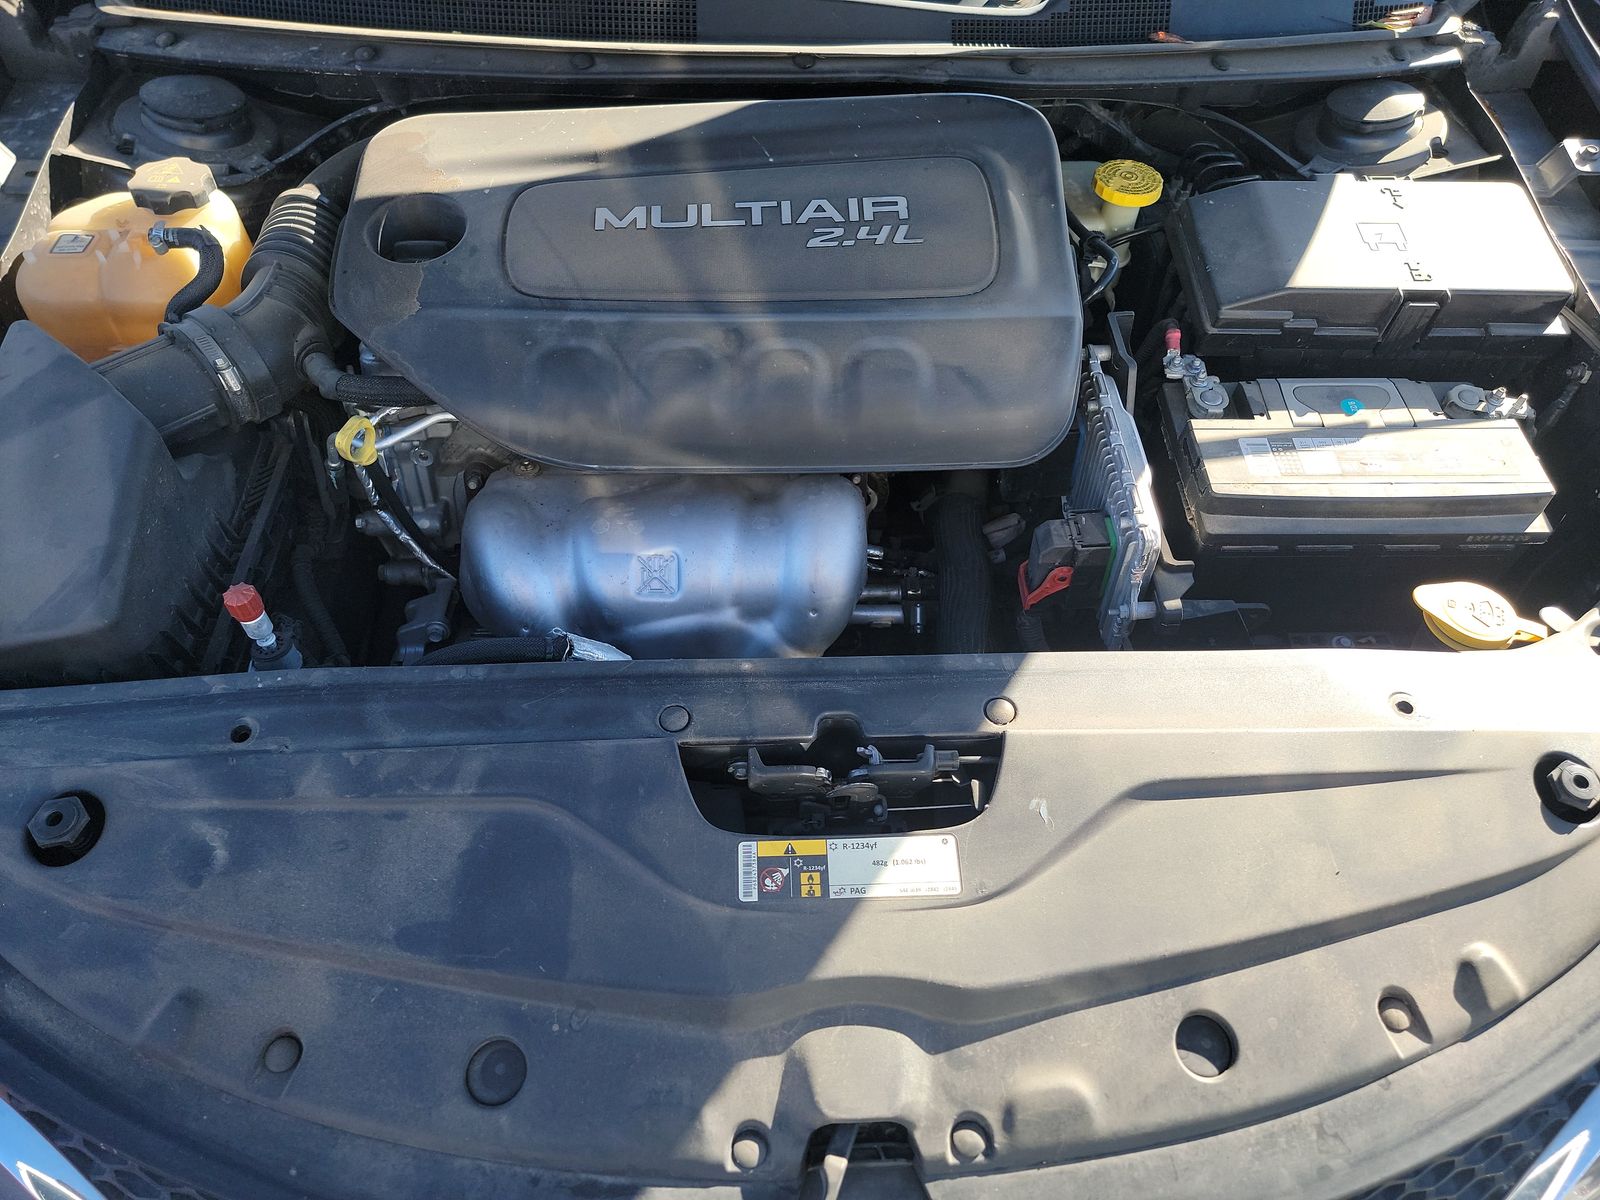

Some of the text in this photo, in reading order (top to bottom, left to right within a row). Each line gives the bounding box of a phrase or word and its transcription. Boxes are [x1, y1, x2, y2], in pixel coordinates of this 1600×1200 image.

[594, 195, 909, 231] MULTIAIR
[806, 225, 924, 248] 2.4L
[842, 841, 878, 851] R-1234yf
[803, 864, 826, 872] R-1234yf
[871, 859, 889, 868] 482g
[850, 887, 867, 895] PAG
